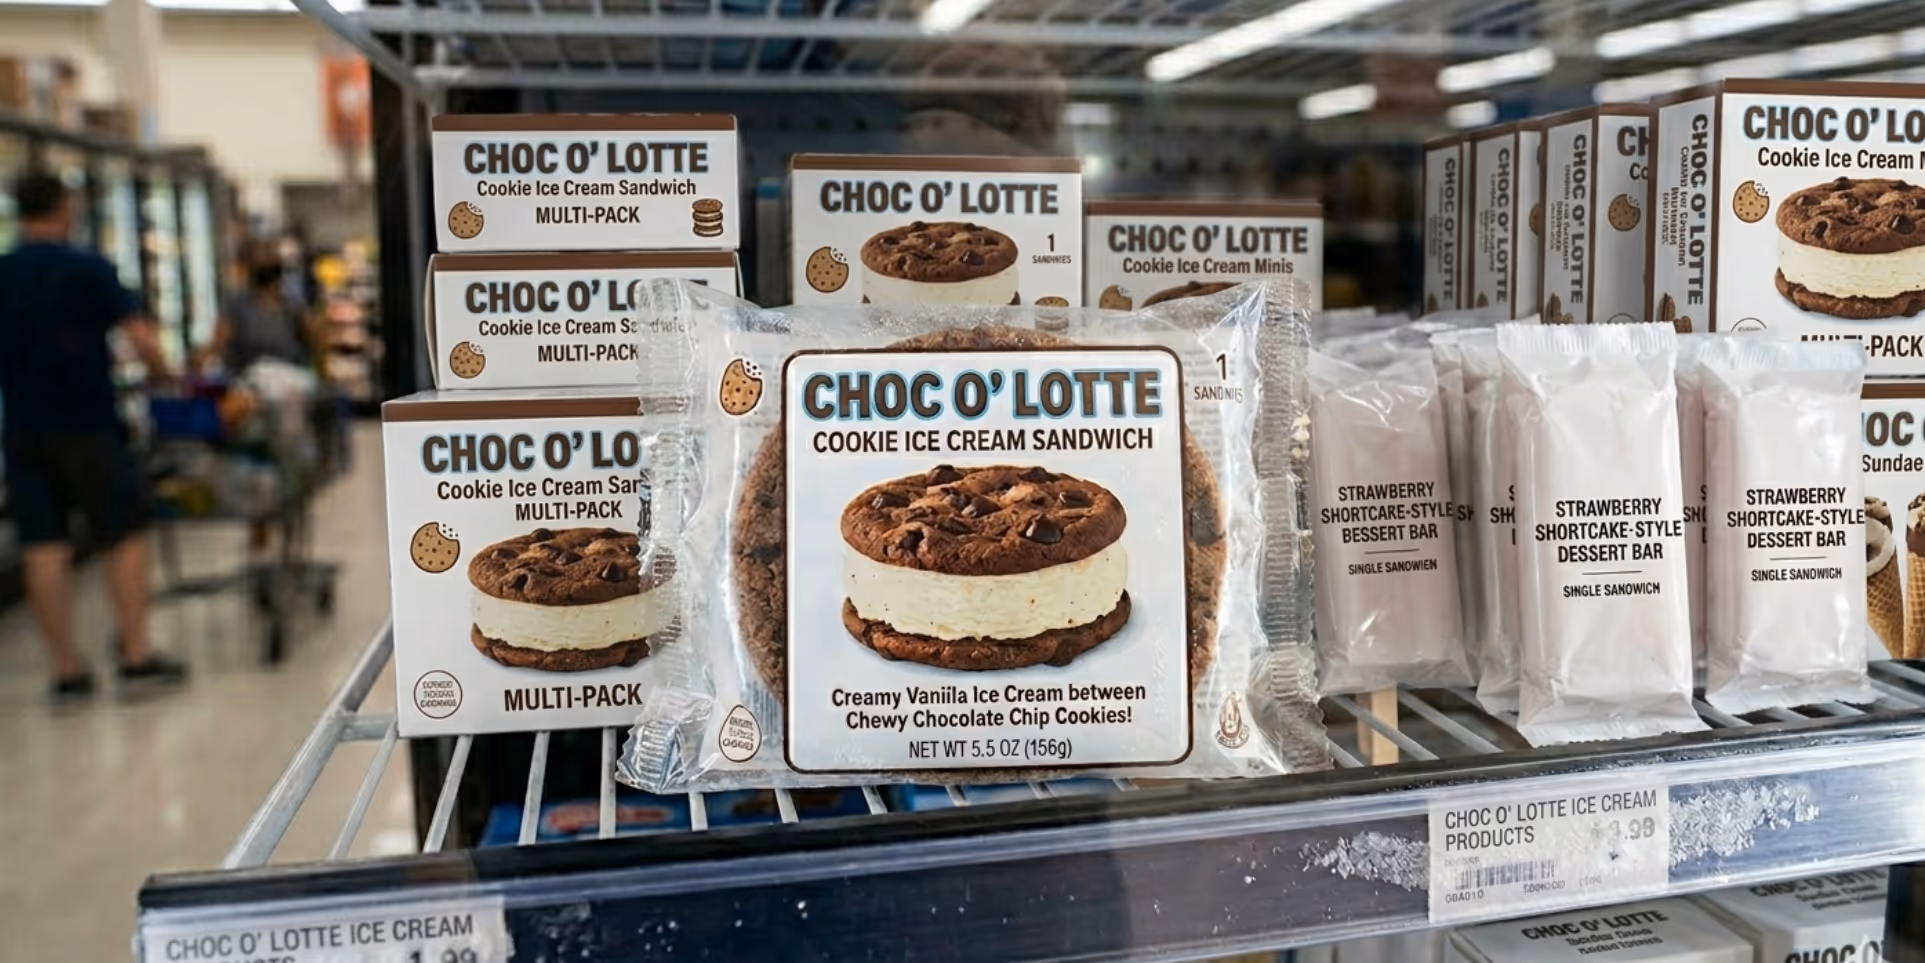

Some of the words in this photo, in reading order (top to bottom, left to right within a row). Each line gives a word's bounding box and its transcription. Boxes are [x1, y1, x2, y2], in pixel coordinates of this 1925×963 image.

[1744, 105, 1837, 141] CHOC
[464, 142, 558, 174] CHOC
[607, 142, 708, 173] LOTTE
[1691, 114, 1709, 188] CHOC
[1758, 147, 1819, 168] Cookie
[1825, 149, 1851, 168] Ice
[1857, 150, 1914, 169] Cream
[1572, 134, 1587, 200] CHOC
[477, 180, 531, 196] Cookie
[536, 180, 559, 195] Ice
[563, 180, 615, 195] Cream
[619, 179, 696, 195] Sandwich
[820, 180, 912, 213] CHOC
[960, 183, 1058, 214] LOTTE
[536, 206, 640, 224] MULTI-PACK
[1048, 233, 1054, 252] 1
[1108, 225, 1186, 253] CHOC
[1226, 226, 1308, 254] LOTTE
[1123, 258, 1173, 273] Cookie
[1178, 258, 1199, 273] Ice
[1203, 258, 1250, 273] Cream
[1255, 258, 1293, 274] Minis
[1570, 233, 1584, 304] LOTTE
[1687, 225, 1705, 305] LOTTE
[465, 281, 559, 313] CHOC
[479, 320, 533, 336] Cookie
[537, 319, 560, 335] Ice
[565, 319, 616, 335] Cream
[1216, 353, 1226, 380] 1
[803, 369, 943, 420] CHOC
[1013, 369, 1162, 419] LOTTE
[813, 430, 898, 454] COOKIE
[905, 430, 940, 452] ICE
[947, 429, 1026, 452] CREAM
[1032, 427, 1153, 450] SANDWICH
[423, 434, 535, 473] CHOC
[1862, 454, 1923, 472] Sundae
[437, 479, 503, 500] Cookie
[508, 479, 537, 498] Ice
[542, 477, 603, 496] Cream
[1338, 482, 1435, 501] STRAWBERRY
[1746, 487, 1846, 505] STRAWBERRY
[515, 500, 623, 521] MULTI-PACK
[1556, 498, 1662, 518] STRAWBERRY
[1727, 509, 1865, 527] SHORTCAKE-STYLE
[1409, 523, 1439, 540] BAR
[1535, 520, 1682, 541] SHORTCAKE-STYLE
[1748, 532, 1812, 548] DESSERT
[1817, 531, 1846, 547] BAR
[1558, 544, 1627, 563] DESSERT
[1632, 543, 1663, 560] BAR
[1348, 562, 1383, 575] SINGLE
[1751, 569, 1787, 582] SINGLE
[1563, 584, 1601, 598] SINGLE
[504, 683, 643, 712] MULTI-PACK
[832, 688, 901, 709] Creamy
[973, 686, 999, 703] Ice
[1004, 685, 1063, 703] Cream
[1069, 684, 1146, 701] between
[846, 711, 908, 732] Chewy
[912, 709, 1004, 728] Chocolate
[1009, 708, 1050, 730] Chip
[1055, 706, 1132, 725] Cookies!
[909, 741, 939, 758] NET
[944, 740, 966, 757] WT
[972, 740, 994, 757] 5.5
[1000, 739, 1019, 756] OZ
[1024, 739, 1073, 760] (156g)
[1445, 807, 1491, 830] CHOC
[1517, 799, 1567, 822] LOTTE
[1572, 796, 1596, 817] ICE
[1601, 790, 1656, 813] CREAM
[1445, 826, 1535, 851] PRODUCTS
[1521, 921, 1580, 940] CHOC
[1602, 910, 1669, 928] LOTTE
[166, 935, 233, 961] CHOC
[271, 924, 342, 951] LOTTE
[351, 921, 385, 945] ICE
[392, 913, 473, 941] CREAM
